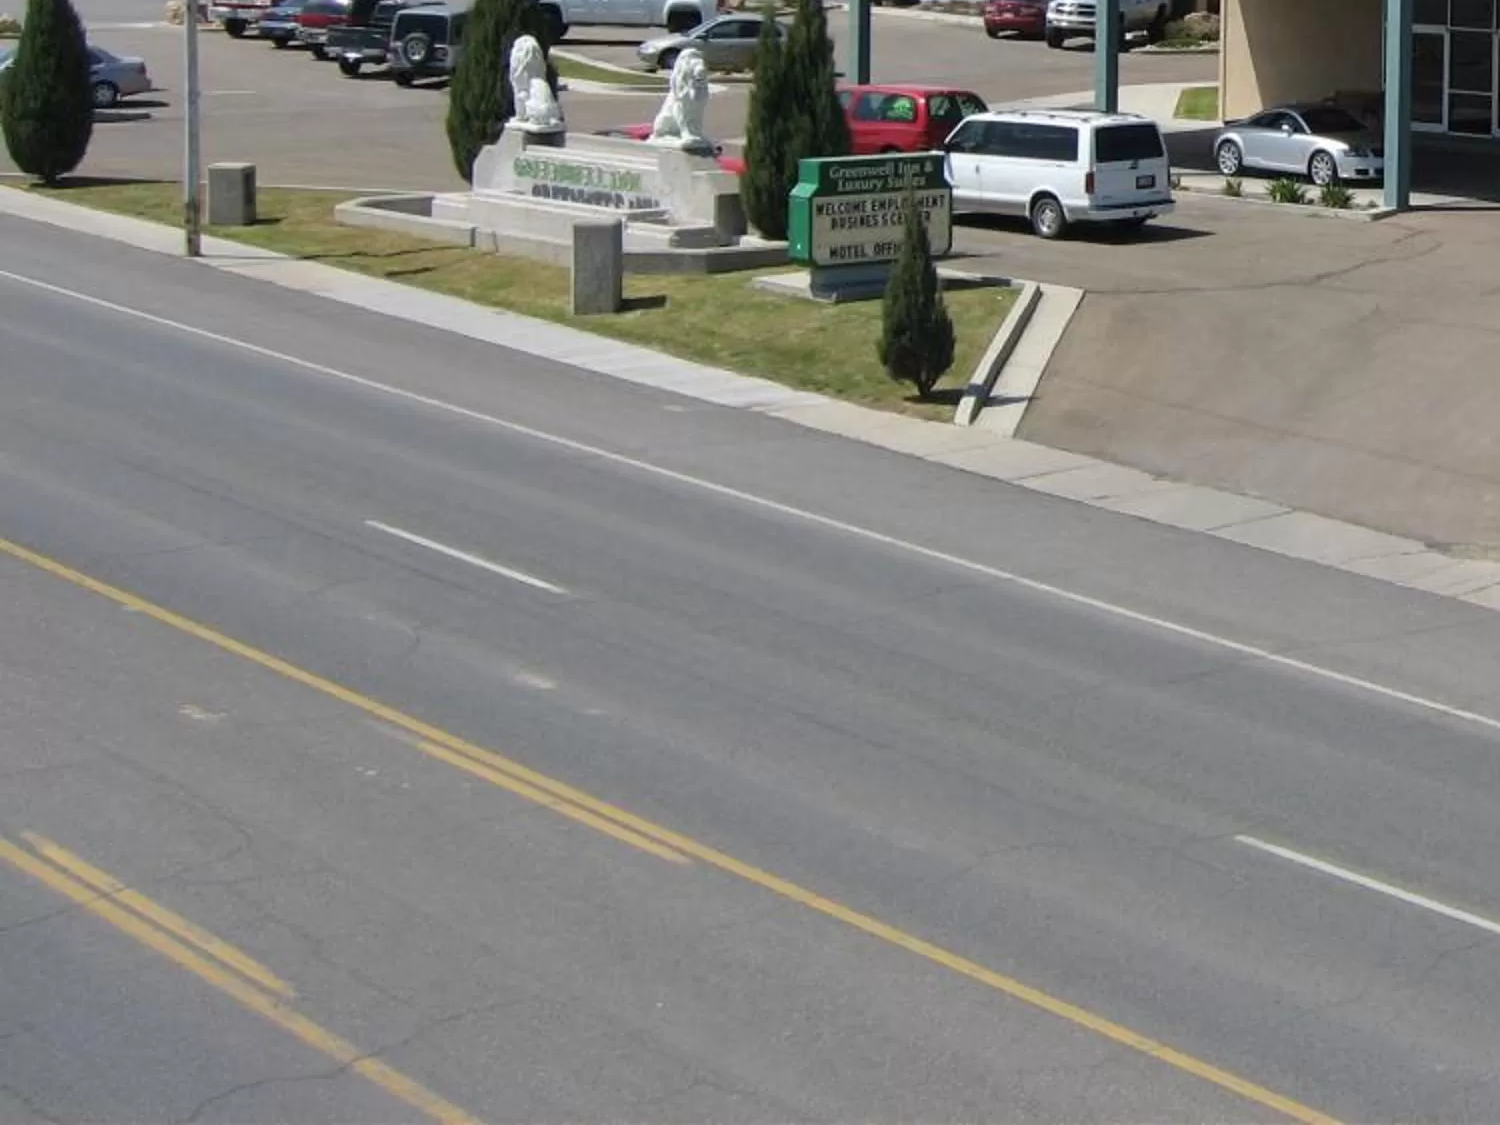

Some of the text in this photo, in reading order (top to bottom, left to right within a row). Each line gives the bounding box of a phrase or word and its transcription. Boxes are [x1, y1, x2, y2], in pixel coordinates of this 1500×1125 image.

[829, 159, 934, 179] Greenwell Inn &
[837, 177, 884, 192] Luxury
[816, 194, 946, 215] WELCOME EMPLOMENT
[890, 209, 931, 226] CEER
[829, 244, 866, 260] MOTEL
